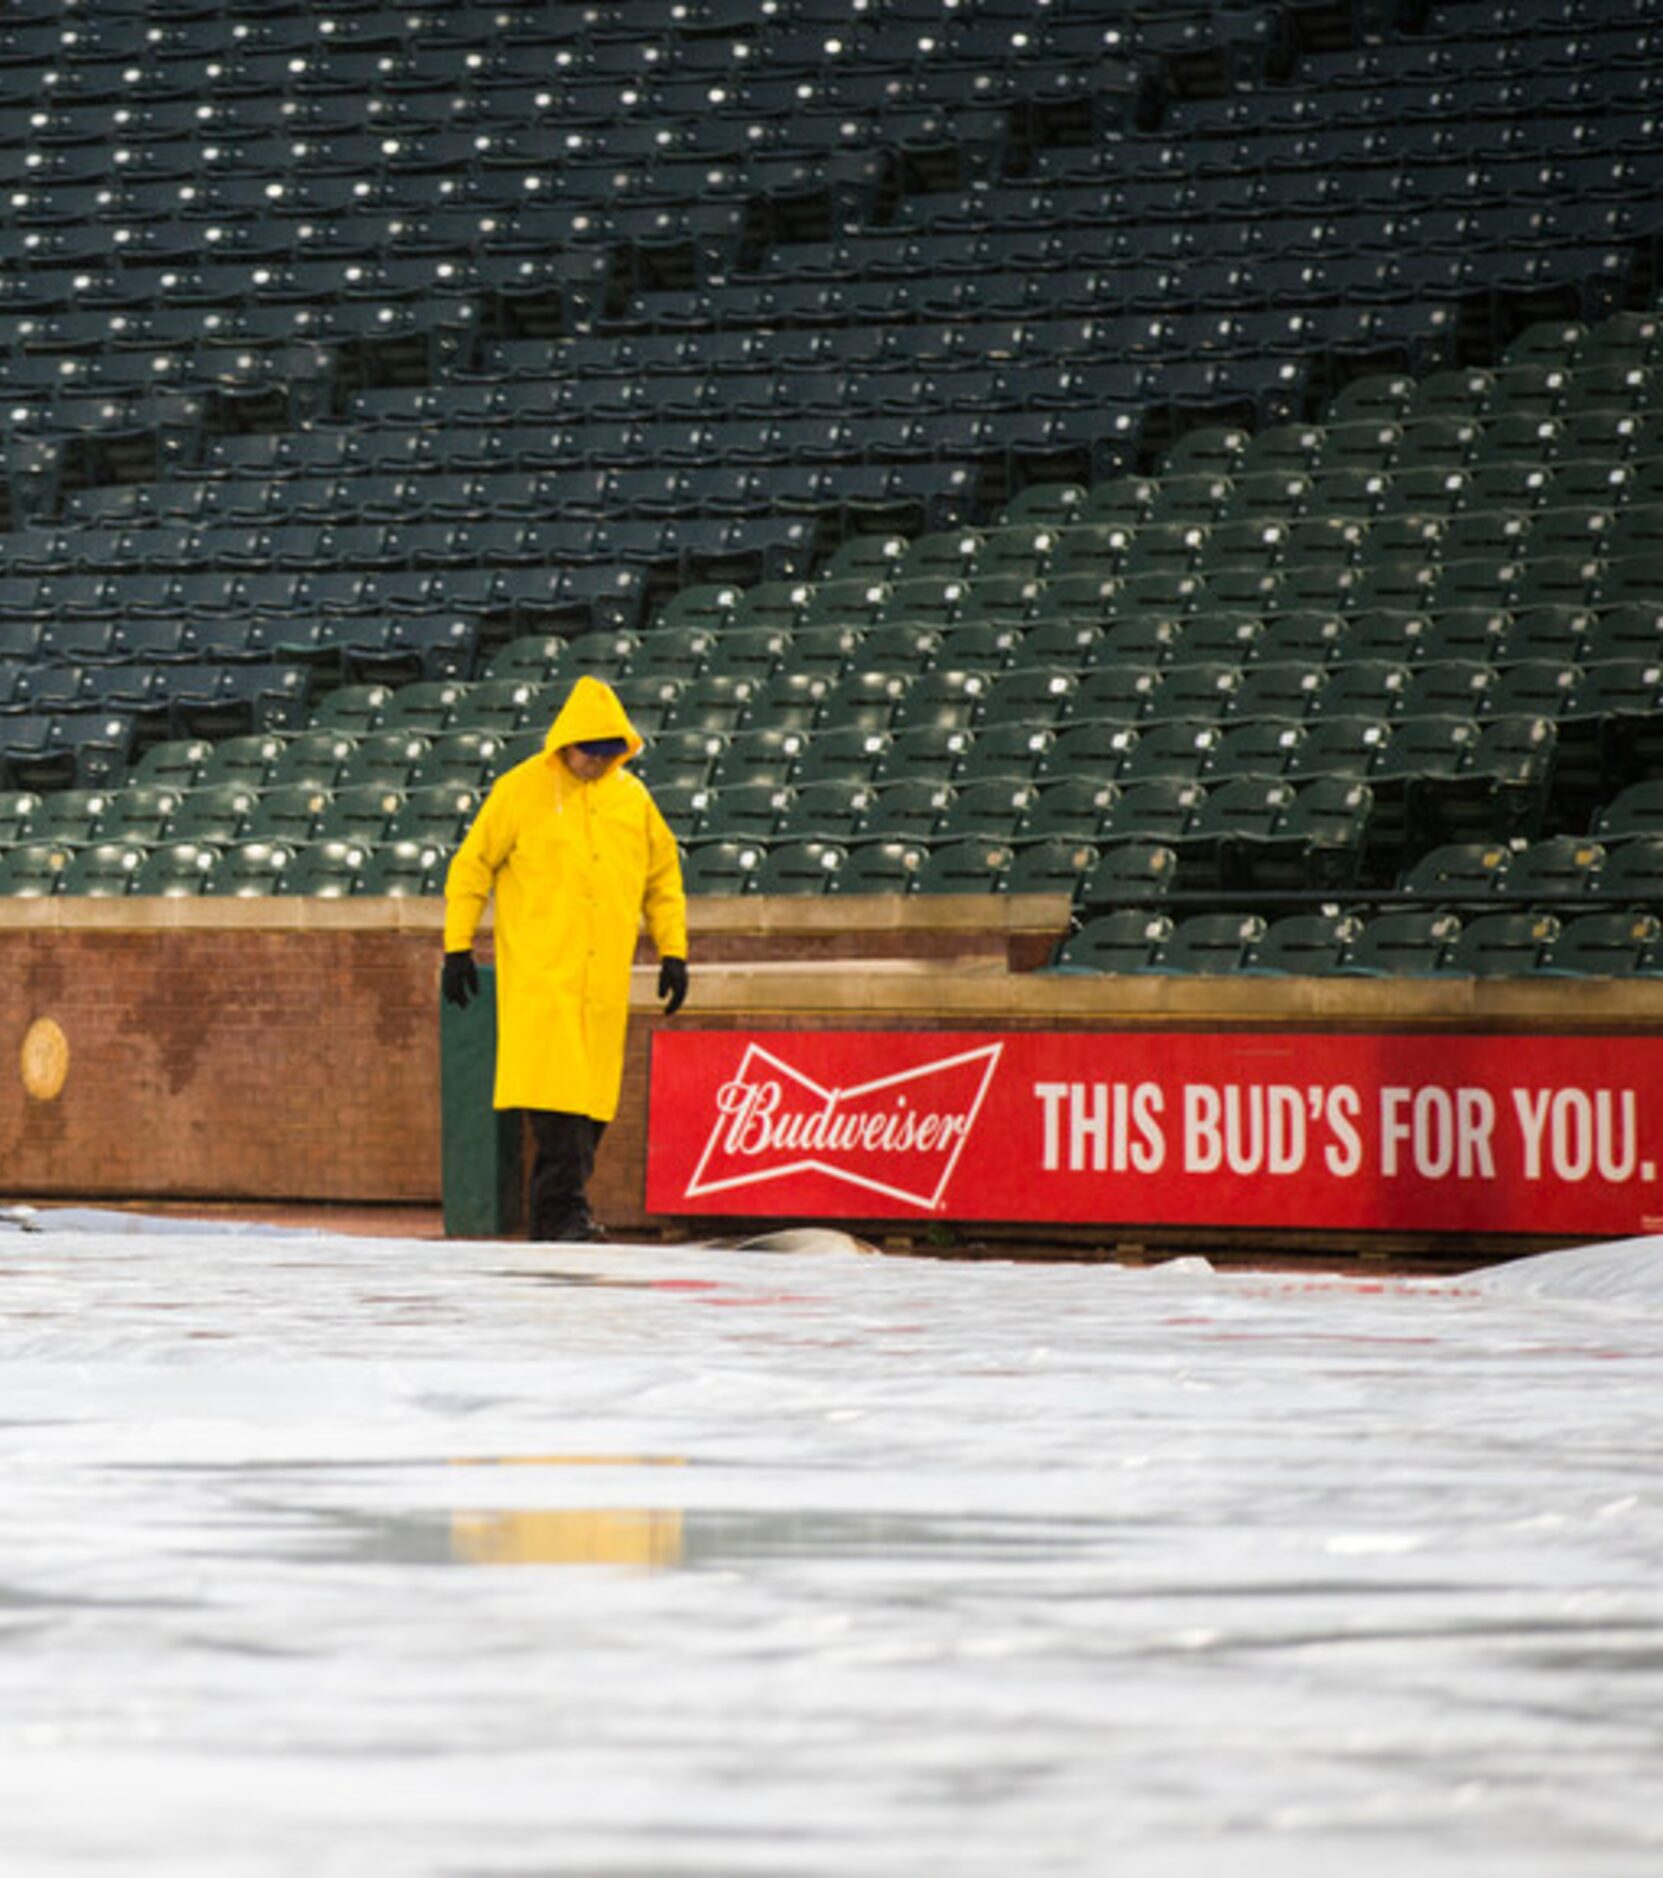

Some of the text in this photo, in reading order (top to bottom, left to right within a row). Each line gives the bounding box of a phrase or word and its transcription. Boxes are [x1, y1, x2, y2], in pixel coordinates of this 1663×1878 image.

[717, 1081, 968, 1155] Budweiser
[1034, 1081, 1656, 1183] THIS BUD'S FOR YOU.
